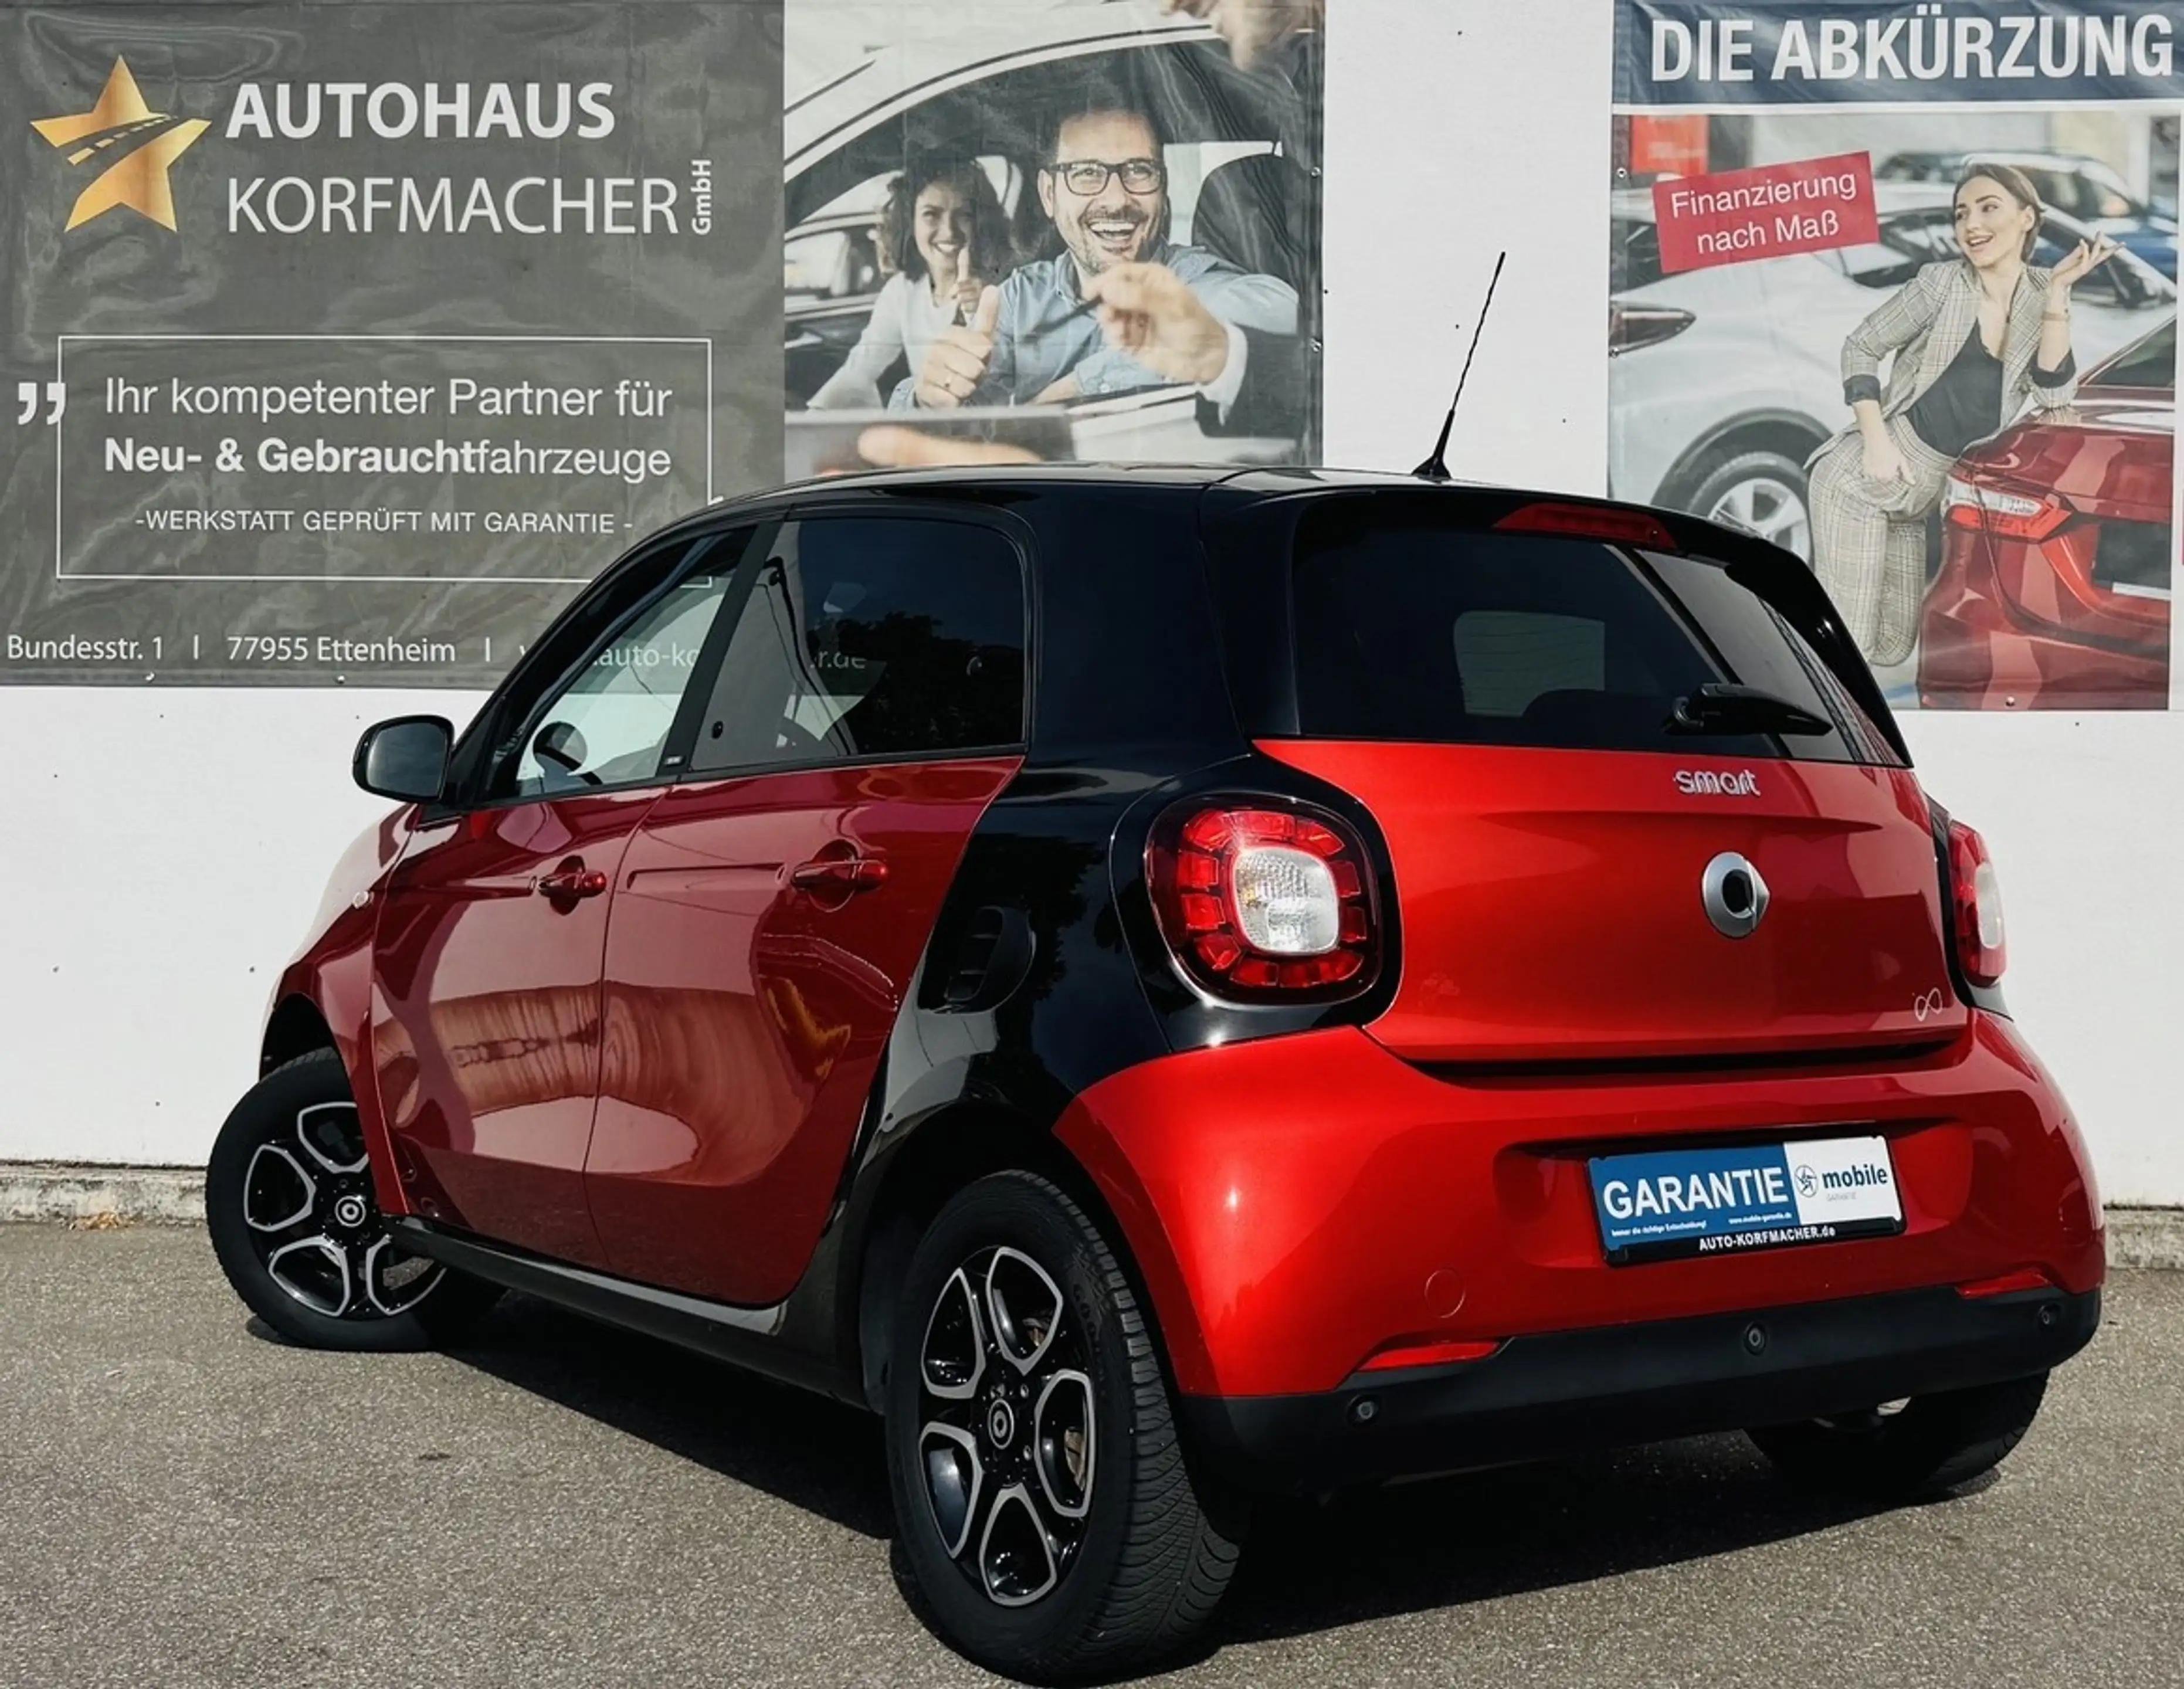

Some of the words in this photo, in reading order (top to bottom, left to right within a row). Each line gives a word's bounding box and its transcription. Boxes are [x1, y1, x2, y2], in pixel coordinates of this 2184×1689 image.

[1651, 19, 1754, 82] DIE
[1770, 4, 2173, 80] ABKÜRZUNG
[225, 82, 615, 138] AUTOHAUS
[229, 177, 679, 233] KORFMACHER
[690, 160, 711, 235] GmbH
[1671, 172, 1857, 219] Finanzierung
[1697, 221, 1766, 255] nach
[1775, 209, 1840, 243] Maß
[107, 377, 158, 413] Ihr
[172, 378, 435, 423] kompetenter
[450, 378, 603, 415] Partner
[615, 380, 673, 416] für
[106, 437, 202, 472] Neu-
[216, 438, 245, 472] &
[257, 437, 671, 484] Gebrauchtfahrzeuge
[136, 510, 294, 530] -WERKSTATT
[303, 507, 422, 531] GEPRÜFT
[431, 512, 476, 531] MIT
[484, 512, 614, 534] GARANTIE
[8, 634, 143, 659] Bundesstr.
[153, 636, 161, 659] 1
[228, 636, 308, 661] 77955
[318, 636, 455, 662] Ettenheim
[1673, 769, 1761, 796] smart
[1603, 1167, 1789, 1219] GARANTIE
[1822, 1164, 1888, 1189] mobile
[1699, 1225, 1836, 1251] AUTO-KORFMACHER.de
